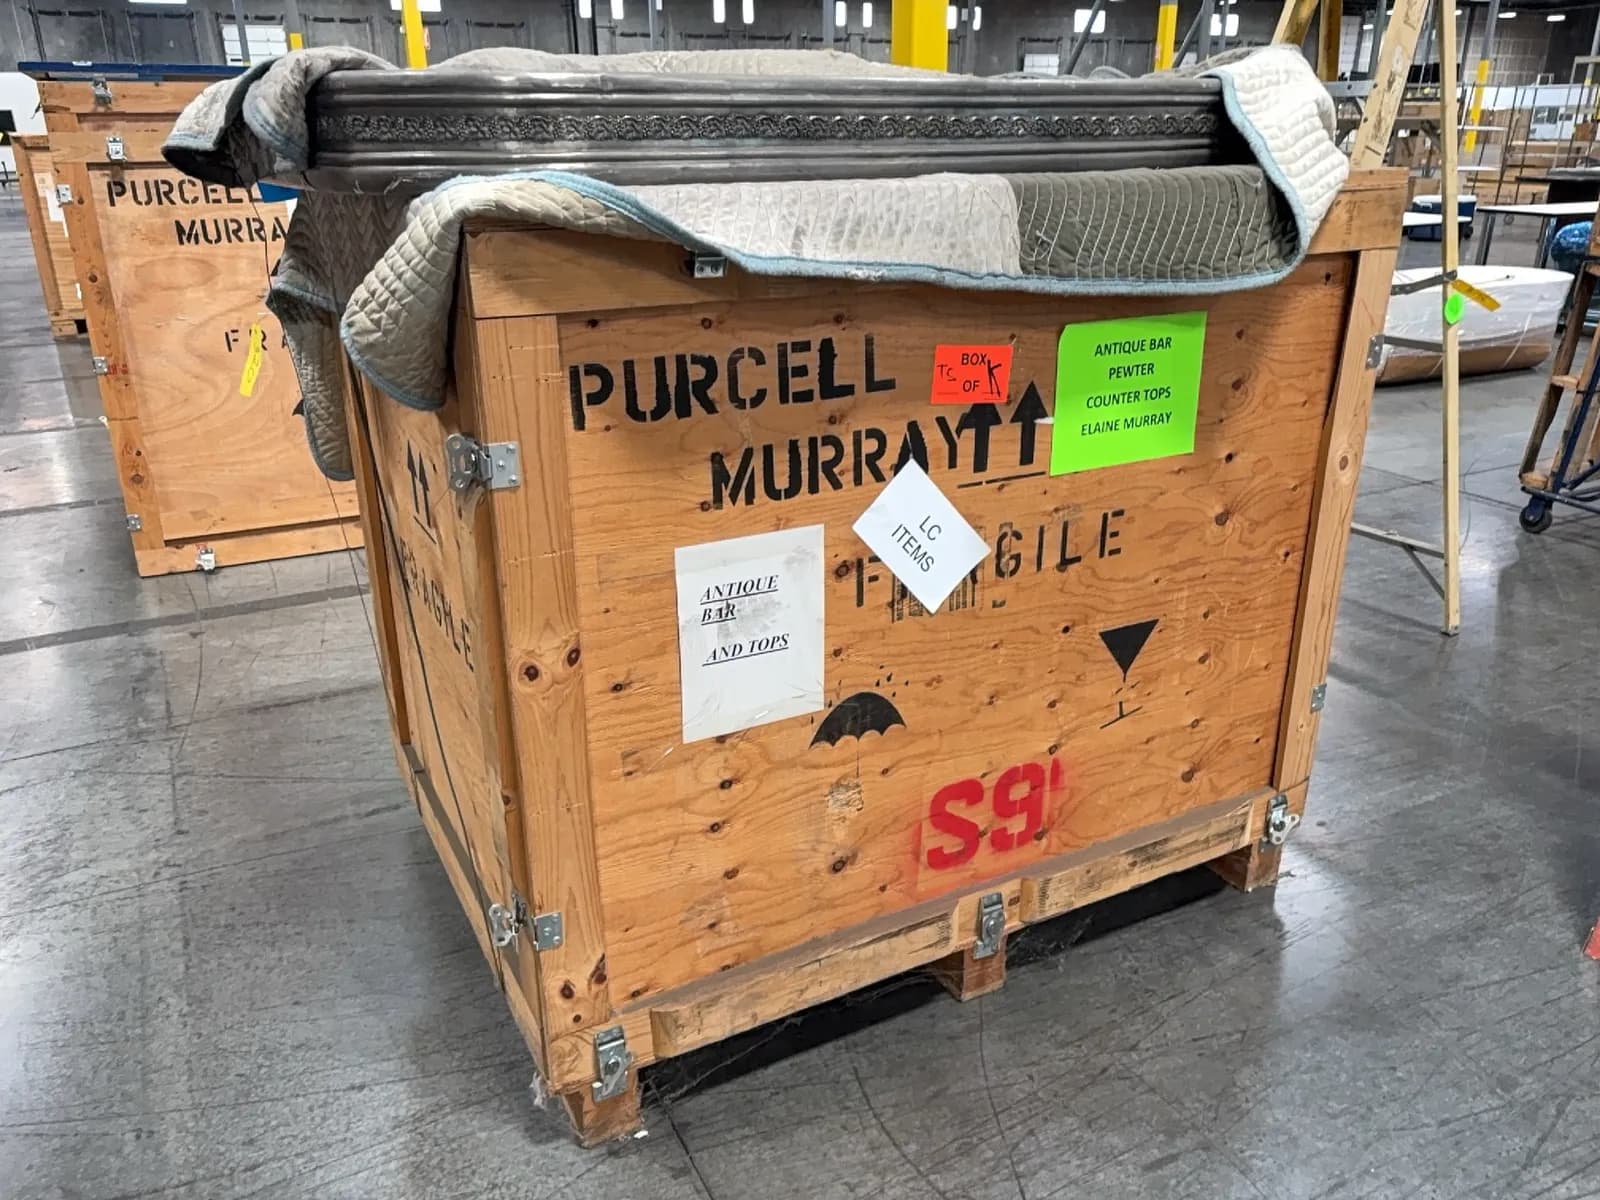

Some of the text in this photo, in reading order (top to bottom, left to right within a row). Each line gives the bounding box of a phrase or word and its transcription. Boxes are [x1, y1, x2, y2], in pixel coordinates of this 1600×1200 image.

[961, 352, 987, 366] BOX
[1094, 336, 1172, 357] ANTIQUE BAR
[569, 334, 896, 431] PURCELL
[1109, 362, 1155, 380] PEWTER
[962, 379, 980, 393] OF
[1086, 386, 1171, 409] COUNTER TOPS
[1081, 410, 1172, 437] ELAINE MURRAY
[919, 515, 942, 541] LC
[856, 508, 1126, 608] FGILE
[891, 523, 935, 573] ITEMS
[700, 575, 779, 604] ANTIQUE
[701, 603, 737, 624] BAR
[706, 633, 790, 663] AND TOPS
